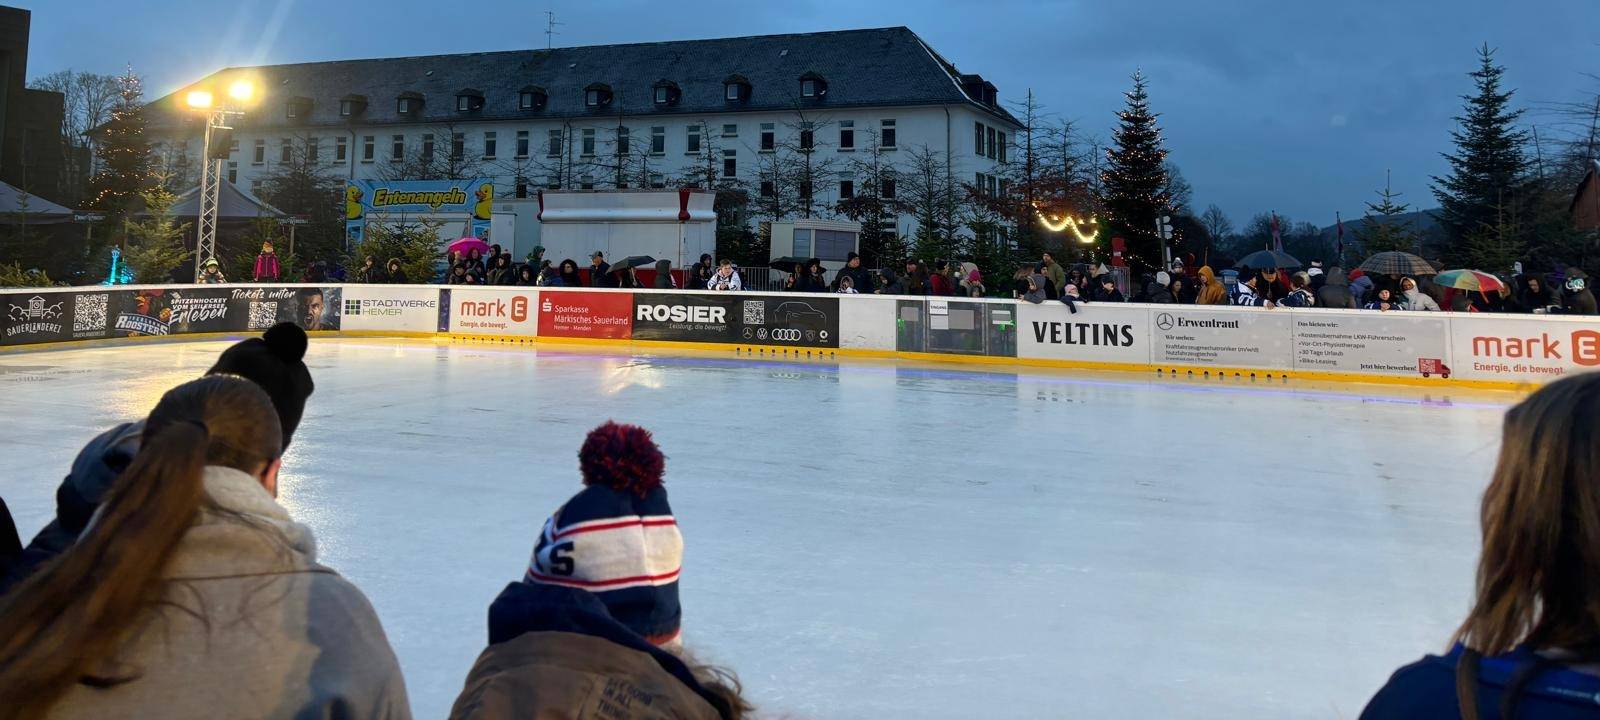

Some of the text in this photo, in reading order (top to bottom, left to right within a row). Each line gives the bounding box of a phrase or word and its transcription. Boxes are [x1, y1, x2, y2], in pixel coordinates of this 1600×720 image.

[372, 187, 467, 208] Entenangeln
[231, 288, 296, 300] Tickets unter
[362, 300, 436, 308] STADTWERKE
[460, 298, 526, 318] mark E
[554, 304, 589, 314] Sparkasse
[168, 306, 228, 324] Erleben
[362, 308, 402, 316] HEMER
[637, 304, 726, 324] ROSIER
[114, 316, 168, 336] ROOSTERS
[460, 320, 479, 329] Energie,
[554, 314, 628, 326] Märkisches Sauerland
[1177, 317, 1240, 329] Erwentraut
[6, 322, 62, 336] SAUERLÄNDEREI
[668, 322, 693, 331] Leistung,
[1032, 321, 1134, 347] VELTINS
[1472, 333, 1598, 361] mark E
[1474, 362, 1511, 374] Energie,
[1513, 364, 1528, 372] die
